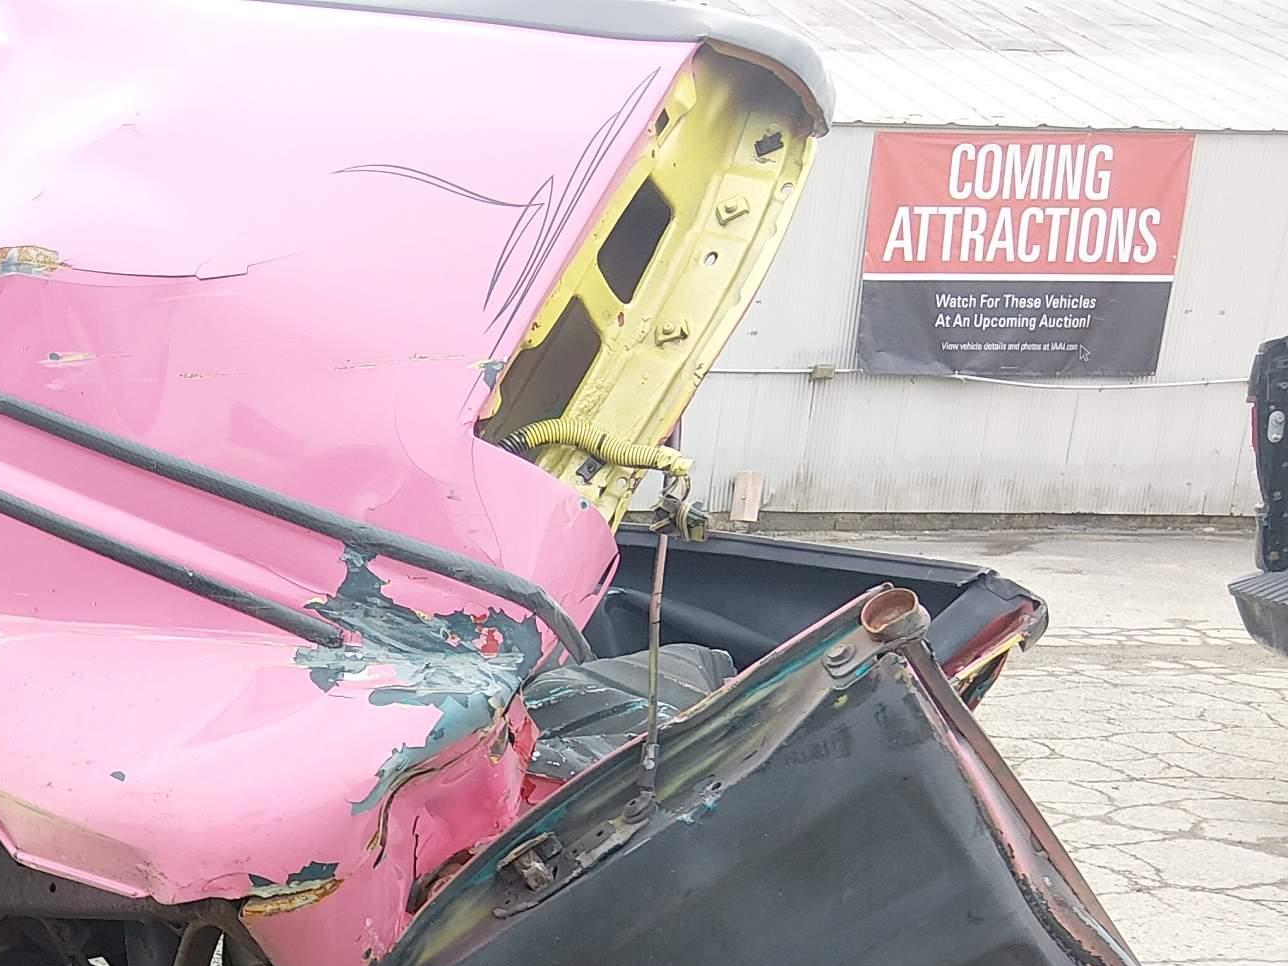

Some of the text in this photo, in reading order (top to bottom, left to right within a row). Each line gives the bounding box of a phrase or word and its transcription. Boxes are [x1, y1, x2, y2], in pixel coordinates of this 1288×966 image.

[948, 143, 1114, 201] COMING
[882, 206, 1161, 263] ATTRACTIONS
[935, 294, 1097, 309] Watch For These Vehicles
[934, 313, 1092, 331] At An Upcoming Auction!
[941, 342, 959, 351] View
[959, 342, 983, 351] vehicle
[983, 342, 1007, 351] details
[1007, 342, 1020, 351] and
[1020, 342, 1042, 353] photos
[1042, 342, 1050, 351] at
